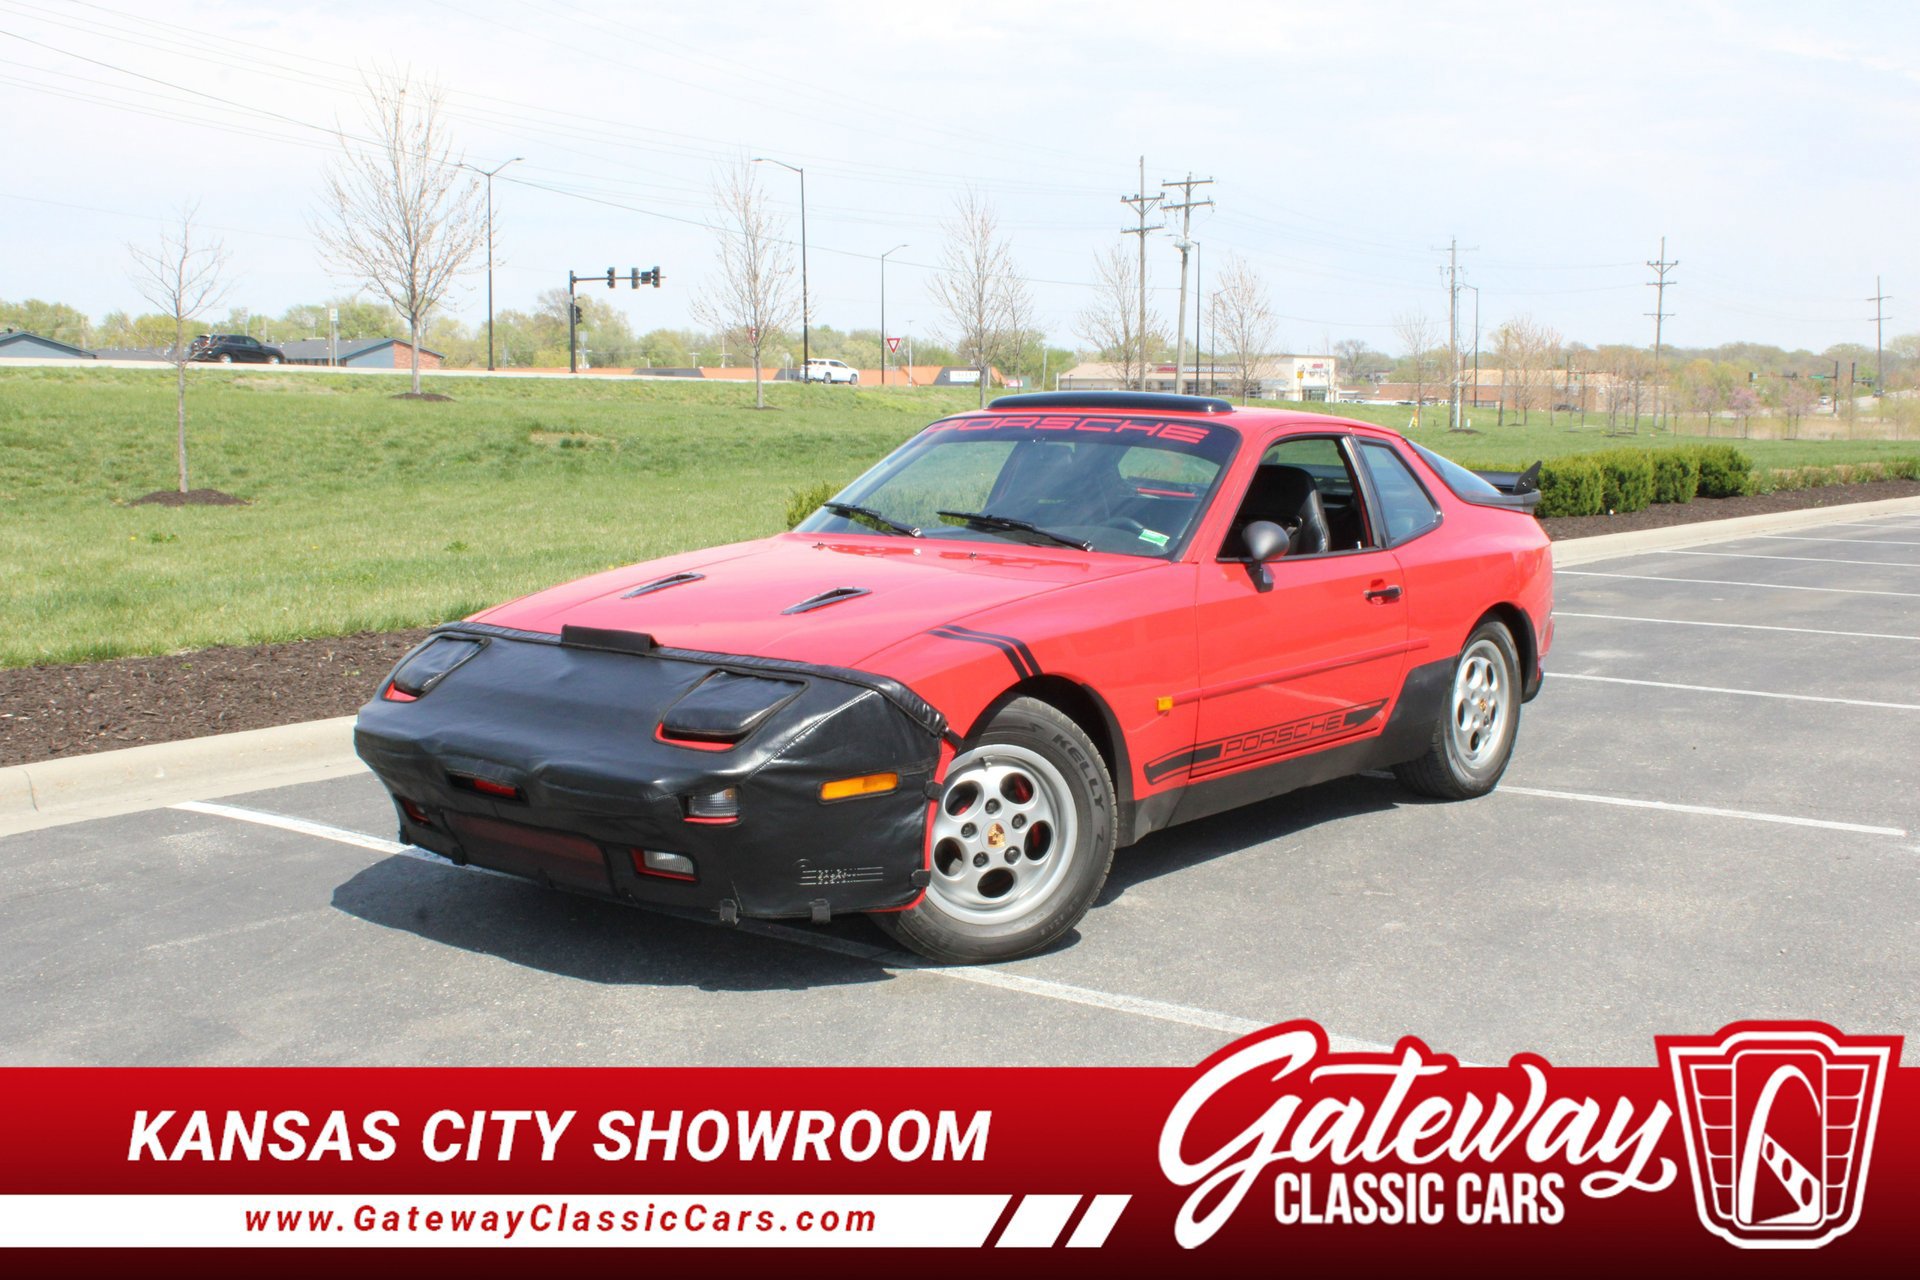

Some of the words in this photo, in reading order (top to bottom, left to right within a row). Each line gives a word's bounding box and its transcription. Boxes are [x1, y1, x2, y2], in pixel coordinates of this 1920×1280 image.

[925, 416, 1209, 443] PORSCHE
[1224, 714, 1342, 756] PORSCHE
[1052, 733, 1105, 811] KELLY
